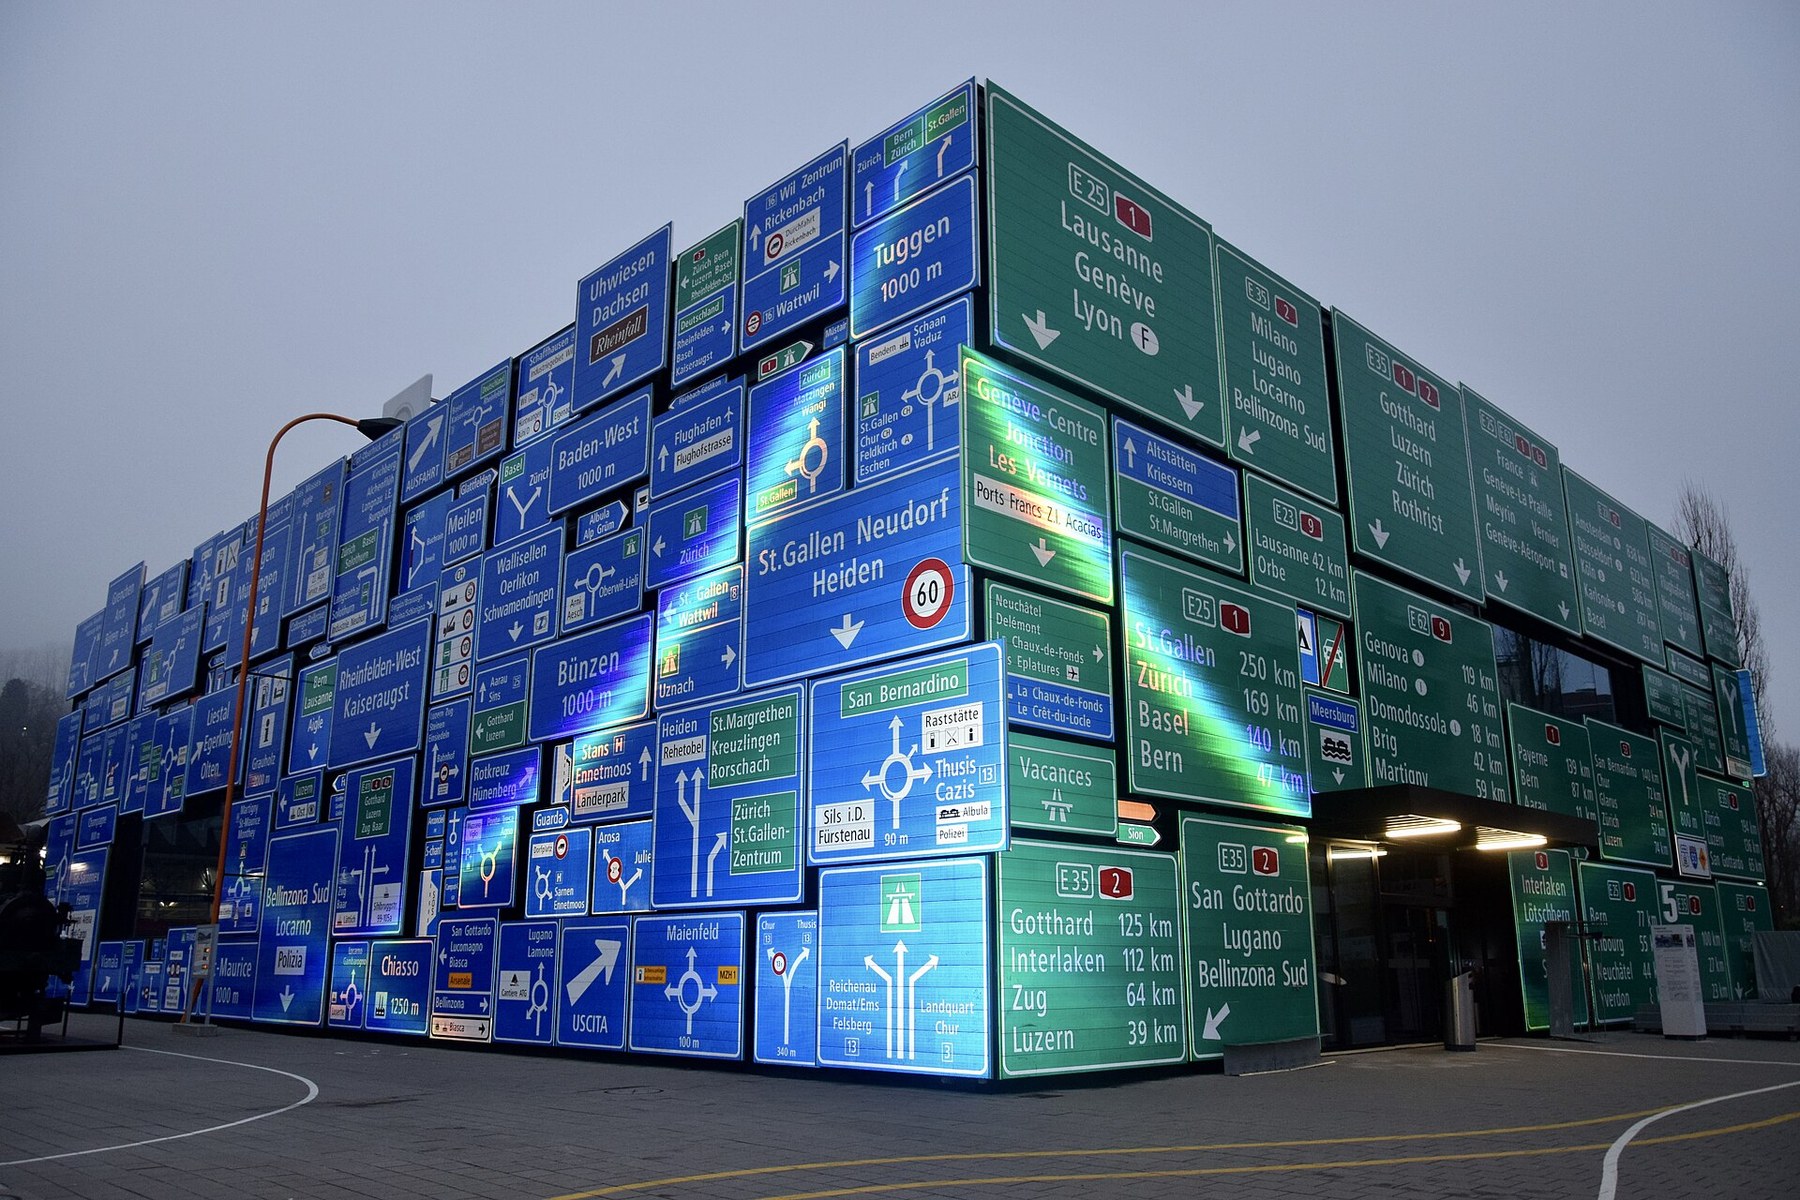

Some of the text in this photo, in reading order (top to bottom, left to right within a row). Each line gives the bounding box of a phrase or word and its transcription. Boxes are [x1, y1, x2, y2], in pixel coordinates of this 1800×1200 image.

[893, 128, 913, 145] Bern
[891, 139, 916, 160] Zürich
[857, 153, 881, 173] Zürich
[765, 187, 825, 231] Rickenbach
[873, 216, 950, 268] Tuggen
[1061, 201, 1163, 283] Lausanne
[590, 252, 654, 301] Uhwiesen
[881, 261, 941, 302] 1000 m
[1075, 252, 1155, 317] Genève
[593, 282, 649, 326] Dachsen
[596, 315, 642, 354] Rheinfall
[914, 315, 946, 336] Schaan
[1251, 312, 1298, 355] Milano
[914, 331, 942, 349] Vaduz
[1252, 341, 1301, 385] Lugano
[1253, 370, 1305, 414] Locarno
[860, 412, 898, 433] St.Gallen
[977, 377, 1097, 445] Genève-Centre
[1234, 388, 1326, 452] Bellinzona Sud
[1380, 392, 1436, 442] Gotthard
[674, 416, 722, 445] Flughafen
[860, 434, 879, 448] Chur
[1006, 421, 1074, 465] Jonction
[559, 416, 639, 471] Baden-West
[860, 441, 897, 461] Feldkirch
[1391, 427, 1432, 468] Luzern
[504, 458, 522, 477] Basel
[860, 458, 889, 476] Eschen
[1147, 442, 1197, 474] Altstätten
[407, 465, 439, 489] AUSFAHRT
[578, 463, 615, 490] 1000 m
[989, 445, 1087, 500] Les Vernets
[1147, 464, 1193, 495] Kriessern
[1396, 461, 1434, 500] Zürich
[407, 510, 425, 524] Luzern
[448, 507, 482, 535] Meilen
[1393, 490, 1444, 534] Rothrist
[759, 488, 949, 576] St.Gallen Neudorf
[497, 544, 547, 574] Wallisellen
[1256, 528, 1342, 579] Lausanne 42 km
[813, 558, 884, 597] Heiden
[1258, 556, 1286, 581] Orbe
[500, 570, 539, 595] Oerlikon
[484, 587, 554, 623] Schwamendingen
[678, 602, 718, 627] Wattwil
[996, 594, 1041, 617] Neuchâtel
[996, 614, 1040, 635] Delémont
[1587, 607, 1606, 629] Basel
[1366, 632, 1408, 663] Genova
[340, 646, 421, 691] Rheinfelden-West
[558, 651, 619, 686] Bünzen
[1137, 661, 1192, 697] Zürich
[1240, 651, 1295, 688] 250 km
[1367, 661, 1407, 691] Milano
[314, 675, 327, 688] Bern
[660, 678, 694, 698] Uznach
[849, 674, 959, 709] San Bernardino
[304, 691, 332, 709] Lausanne
[344, 681, 410, 719] Kaiseraugst
[562, 690, 612, 718] 1000 m
[1244, 689, 1298, 723] 169 km
[207, 705, 230, 726] Liestal
[926, 710, 979, 727] Raststätte
[1139, 701, 1189, 736] Basel
[1312, 702, 1355, 728] Meersburg
[1370, 696, 1446, 734] Domodossola
[662, 719, 697, 738] Heiden
[582, 743, 609, 760] Stans
[664, 741, 704, 759] Rehetobel
[712, 732, 780, 756] Kreuzlingen
[1246, 725, 1300, 758] 140 km
[1373, 726, 1397, 757] Brig
[711, 756, 769, 779] Rorschach
[936, 756, 993, 781] Thusis 13
[1141, 740, 1182, 773] Bern
[201, 762, 219, 780] Olten
[474, 764, 509, 782] Rotkreuz
[576, 762, 631, 784] Ennetmoos
[1020, 756, 1092, 786] Vacances
[473, 782, 516, 801] Hünenberg
[576, 788, 626, 808] Länderpark
[936, 779, 974, 801] Cazis
[1599, 793, 1618, 808] Glarus
[536, 812, 563, 826] Guarda
[734, 801, 770, 821] Zürich
[1602, 812, 1619, 827] Zürich
[599, 831, 620, 843] Arosa
[819, 827, 870, 844] Fürstenau
[1604, 832, 1623, 847] Luzern
[733, 850, 781, 867] Zentrum
[266, 880, 330, 907] Bellinzona Sud
[1192, 882, 1303, 913] San Gottardo
[1522, 875, 1566, 896] Interlaken
[1661, 885, 1678, 923] 5
[276, 917, 311, 937] Locarno
[452, 924, 491, 936] San Gottardo
[1011, 909, 1172, 937] Gotthard 125 km
[1637, 911, 1645, 926] 77
[1646, 911, 1657, 925] km
[529, 929, 552, 943] Lugano
[667, 923, 718, 941] Maienfeld
[1223, 922, 1281, 957] Lugano
[101, 958, 118, 968] Viamala
[382, 955, 418, 976] Chiasso
[1012, 947, 1173, 973] Interlaken 112 km
[829, 980, 876, 992] Reichenau
[1199, 960, 1308, 988] Bellinzona Sud
[215, 988, 231, 1004] 1000
[826, 998, 879, 1011] Domat/Ems
[921, 1000, 974, 1016] Landquart
[1012, 983, 1175, 1017] Zug 64 km
[572, 1014, 608, 1033] USCITA
[833, 1017, 871, 1034] Felsberg
[936, 1021, 959, 1034] Chur
[1013, 1019, 1177, 1052] Luzern 39 km
